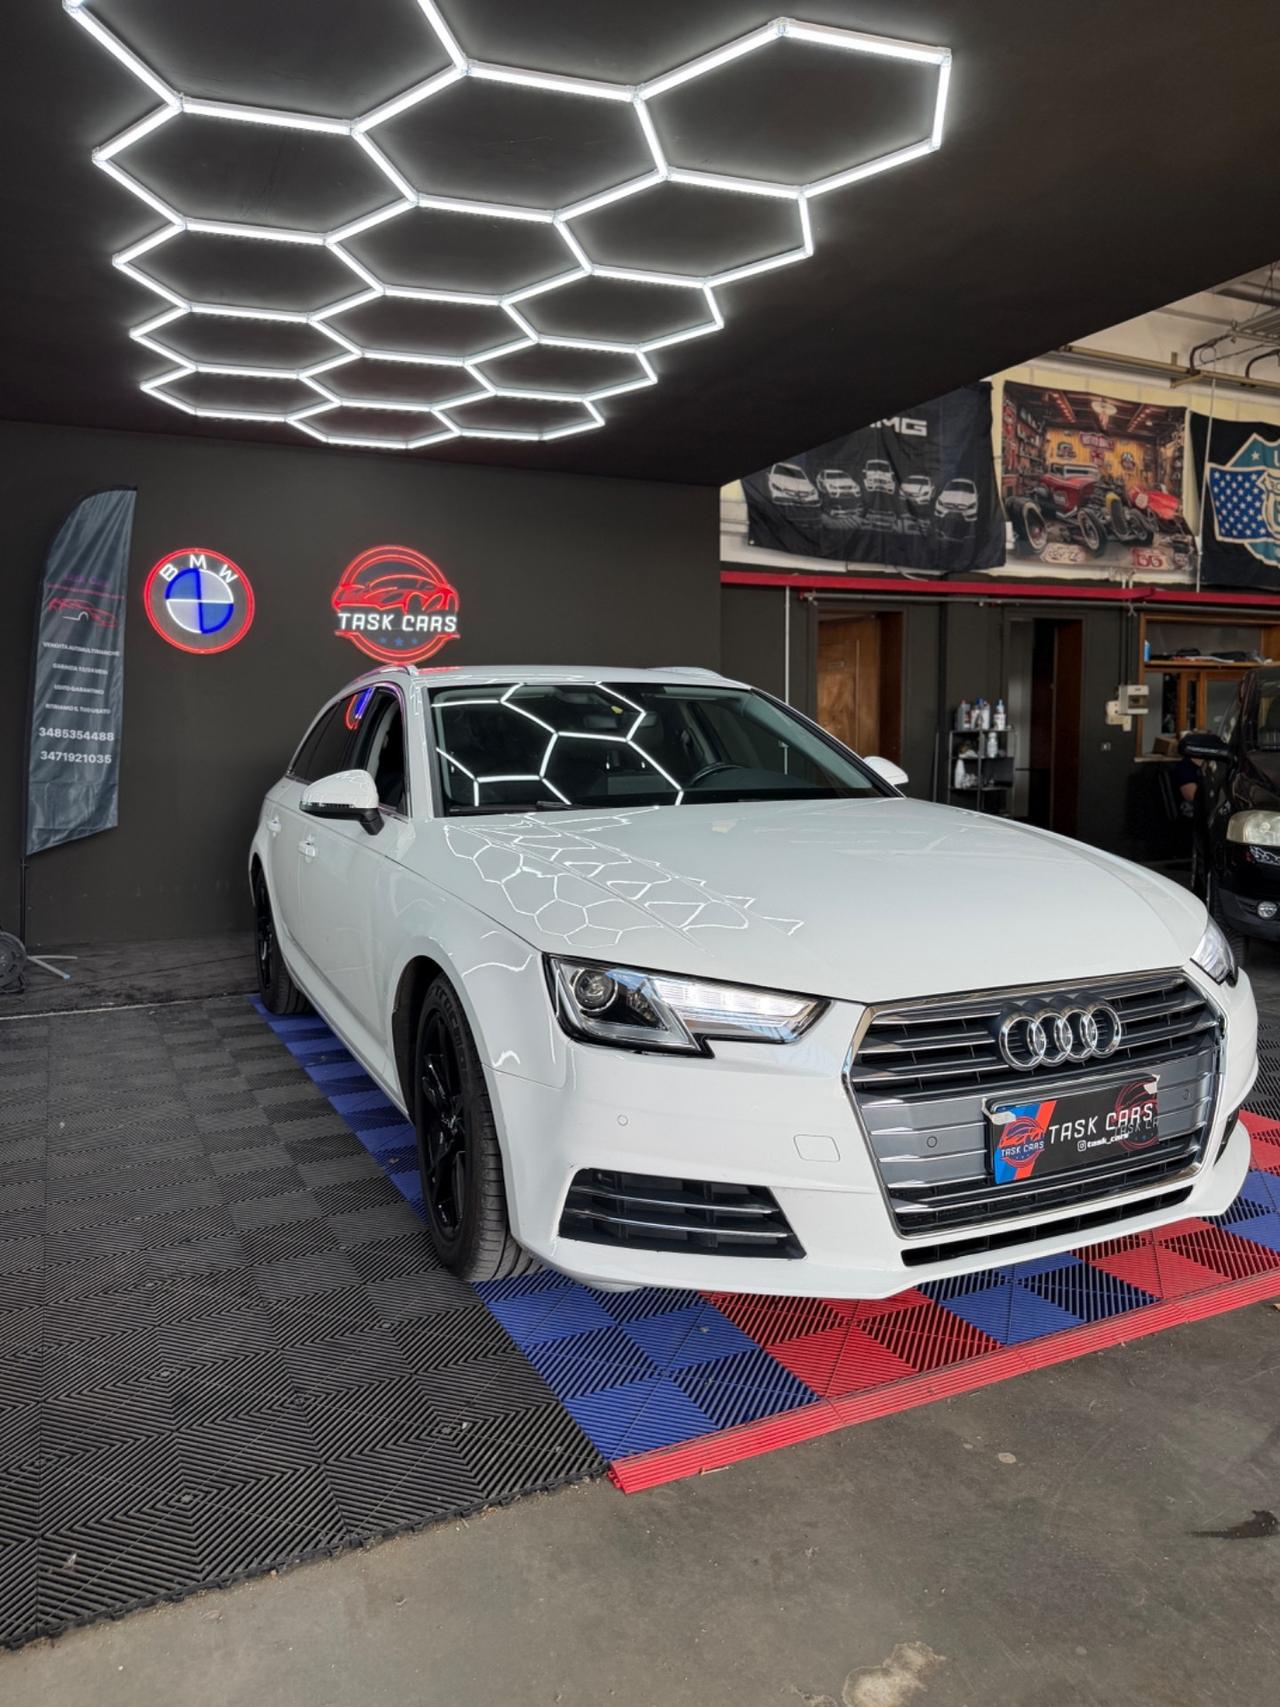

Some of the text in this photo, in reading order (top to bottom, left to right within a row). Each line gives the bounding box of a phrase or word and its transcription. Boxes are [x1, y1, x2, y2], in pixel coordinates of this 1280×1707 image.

[159, 554, 239, 583] BMW
[337, 613, 458, 632] TASK CARS
[38, 727, 115, 741] 3485354488
[40, 750, 112, 764] 3471921035
[1048, 1103, 1153, 1144] TASK CARS
[1001, 1140, 1045, 1157] TASK CARS
